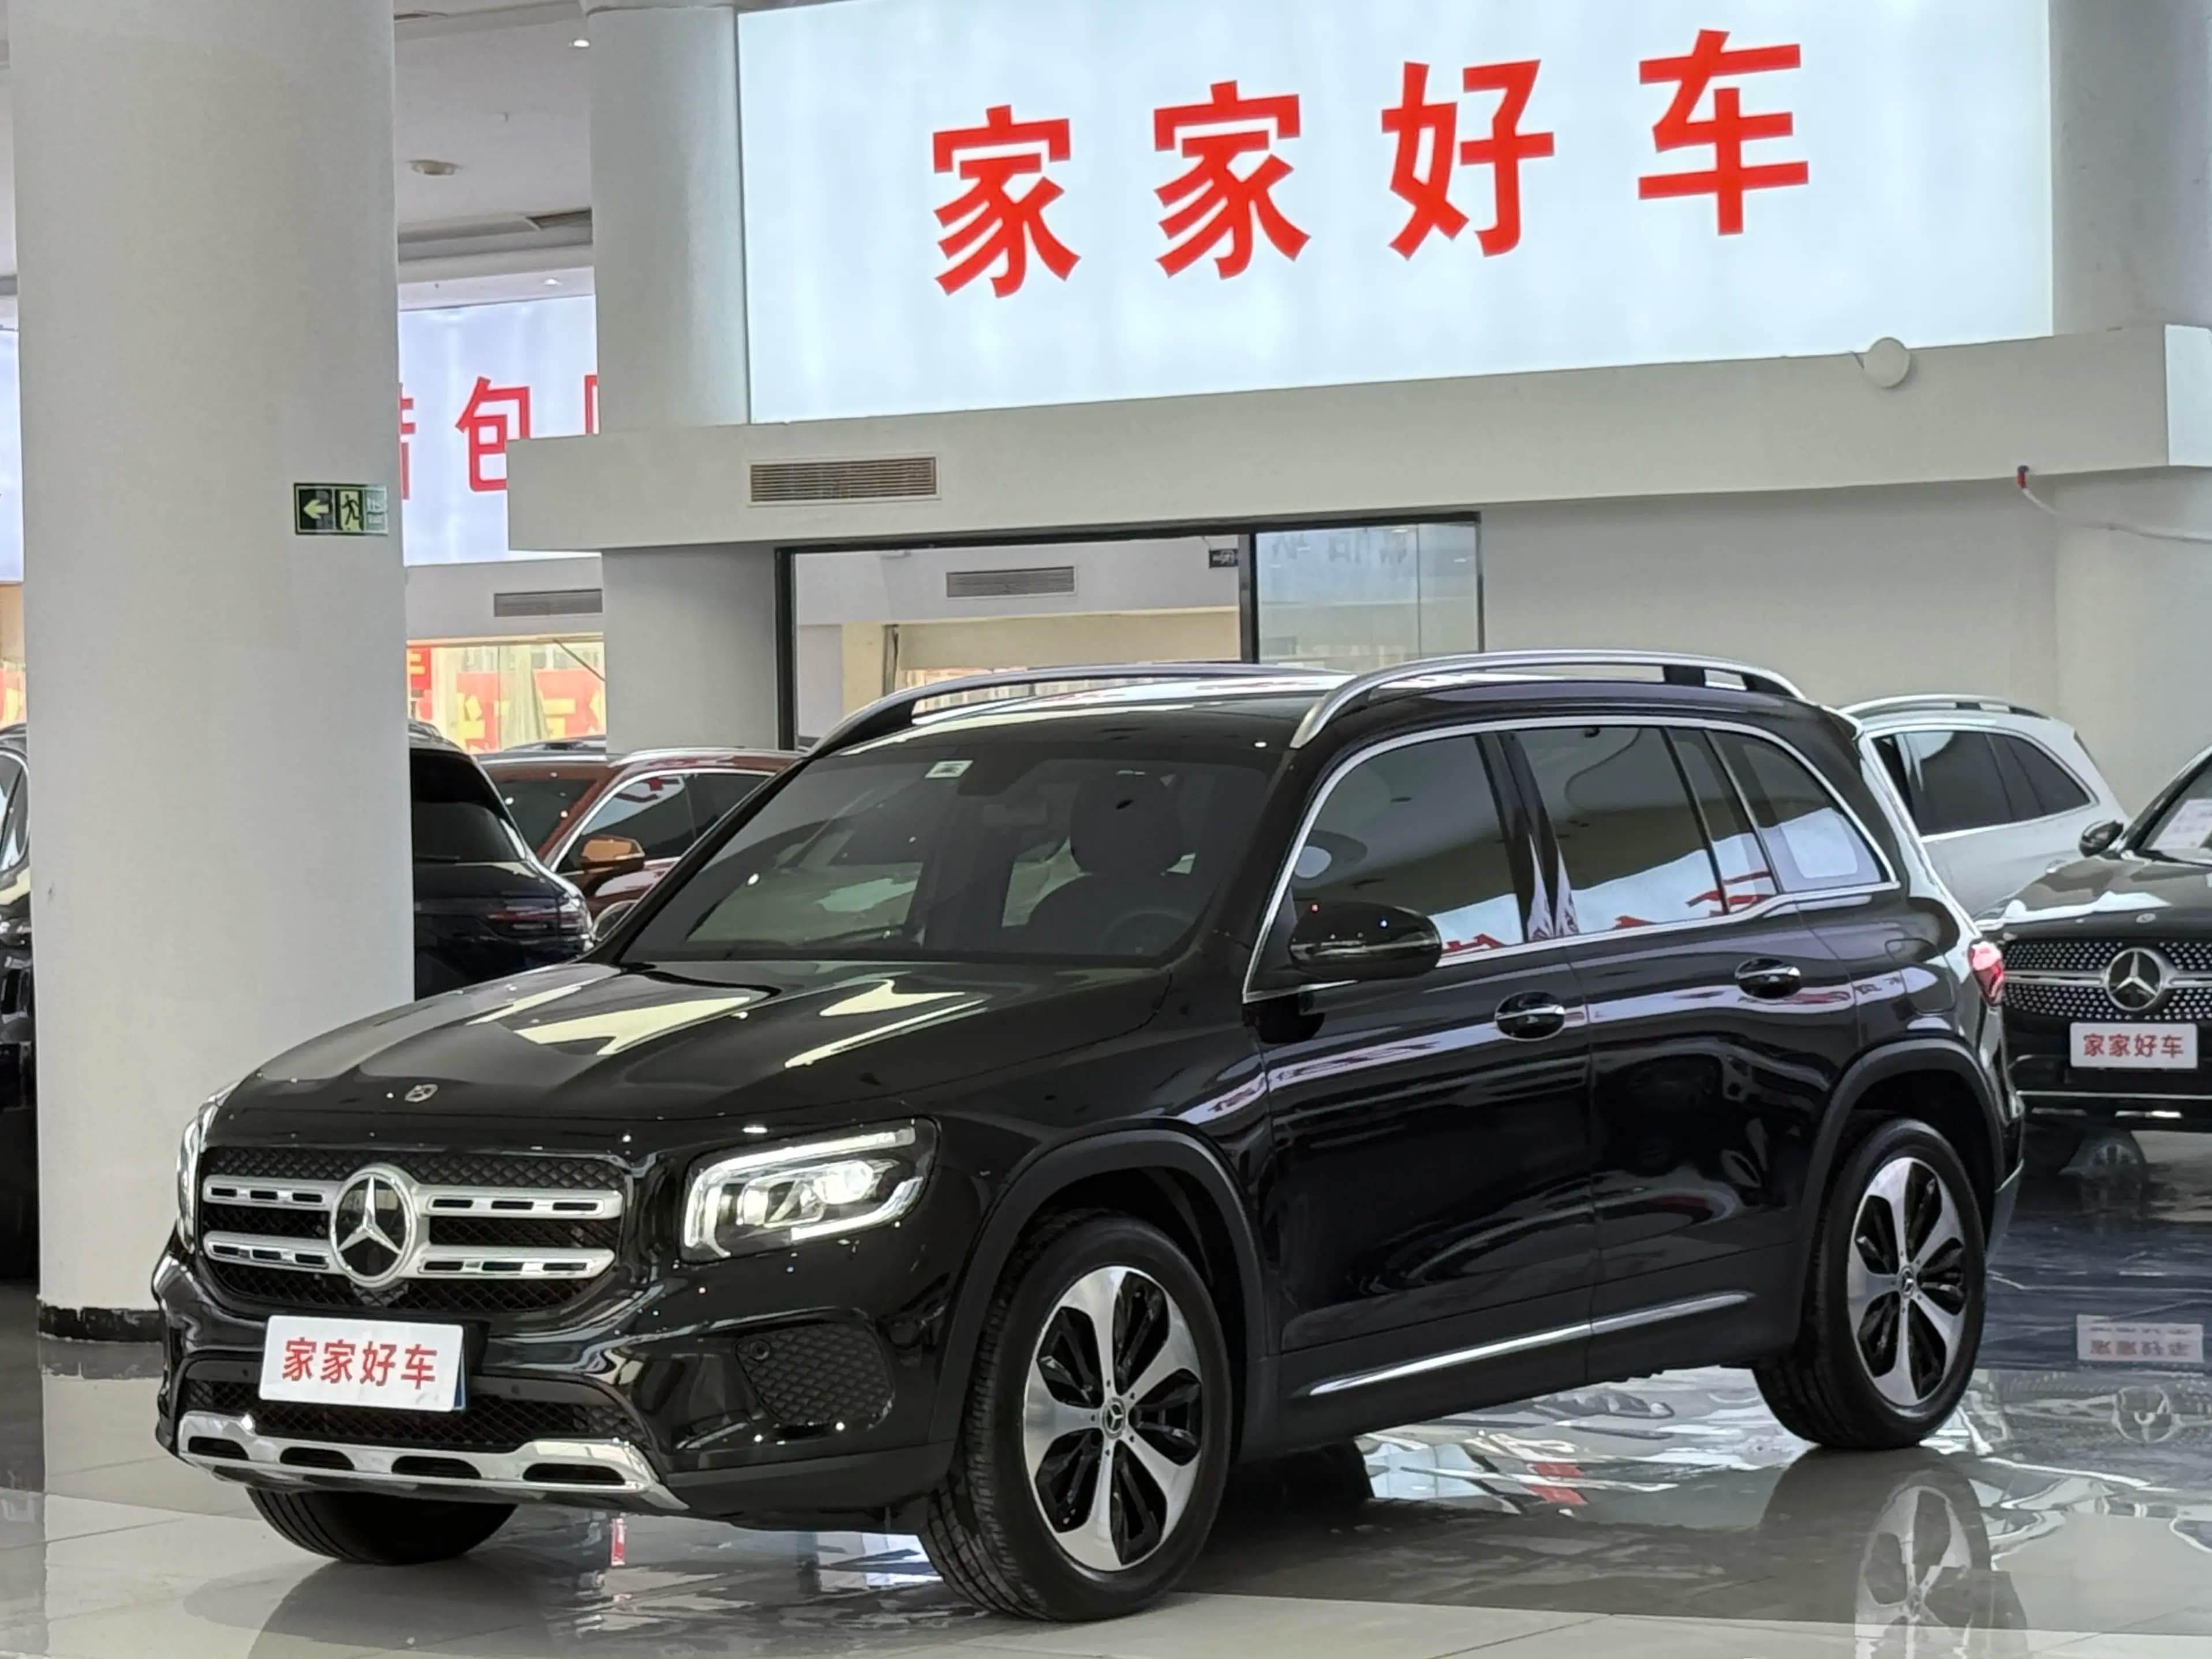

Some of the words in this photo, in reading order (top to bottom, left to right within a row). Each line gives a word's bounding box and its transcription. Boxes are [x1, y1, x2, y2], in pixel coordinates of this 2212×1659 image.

[932, 29, 1809, 299] 家家好车
[2083, 1034, 2184, 1059] 家家好车
[282, 1337, 438, 1389] 家家好车
